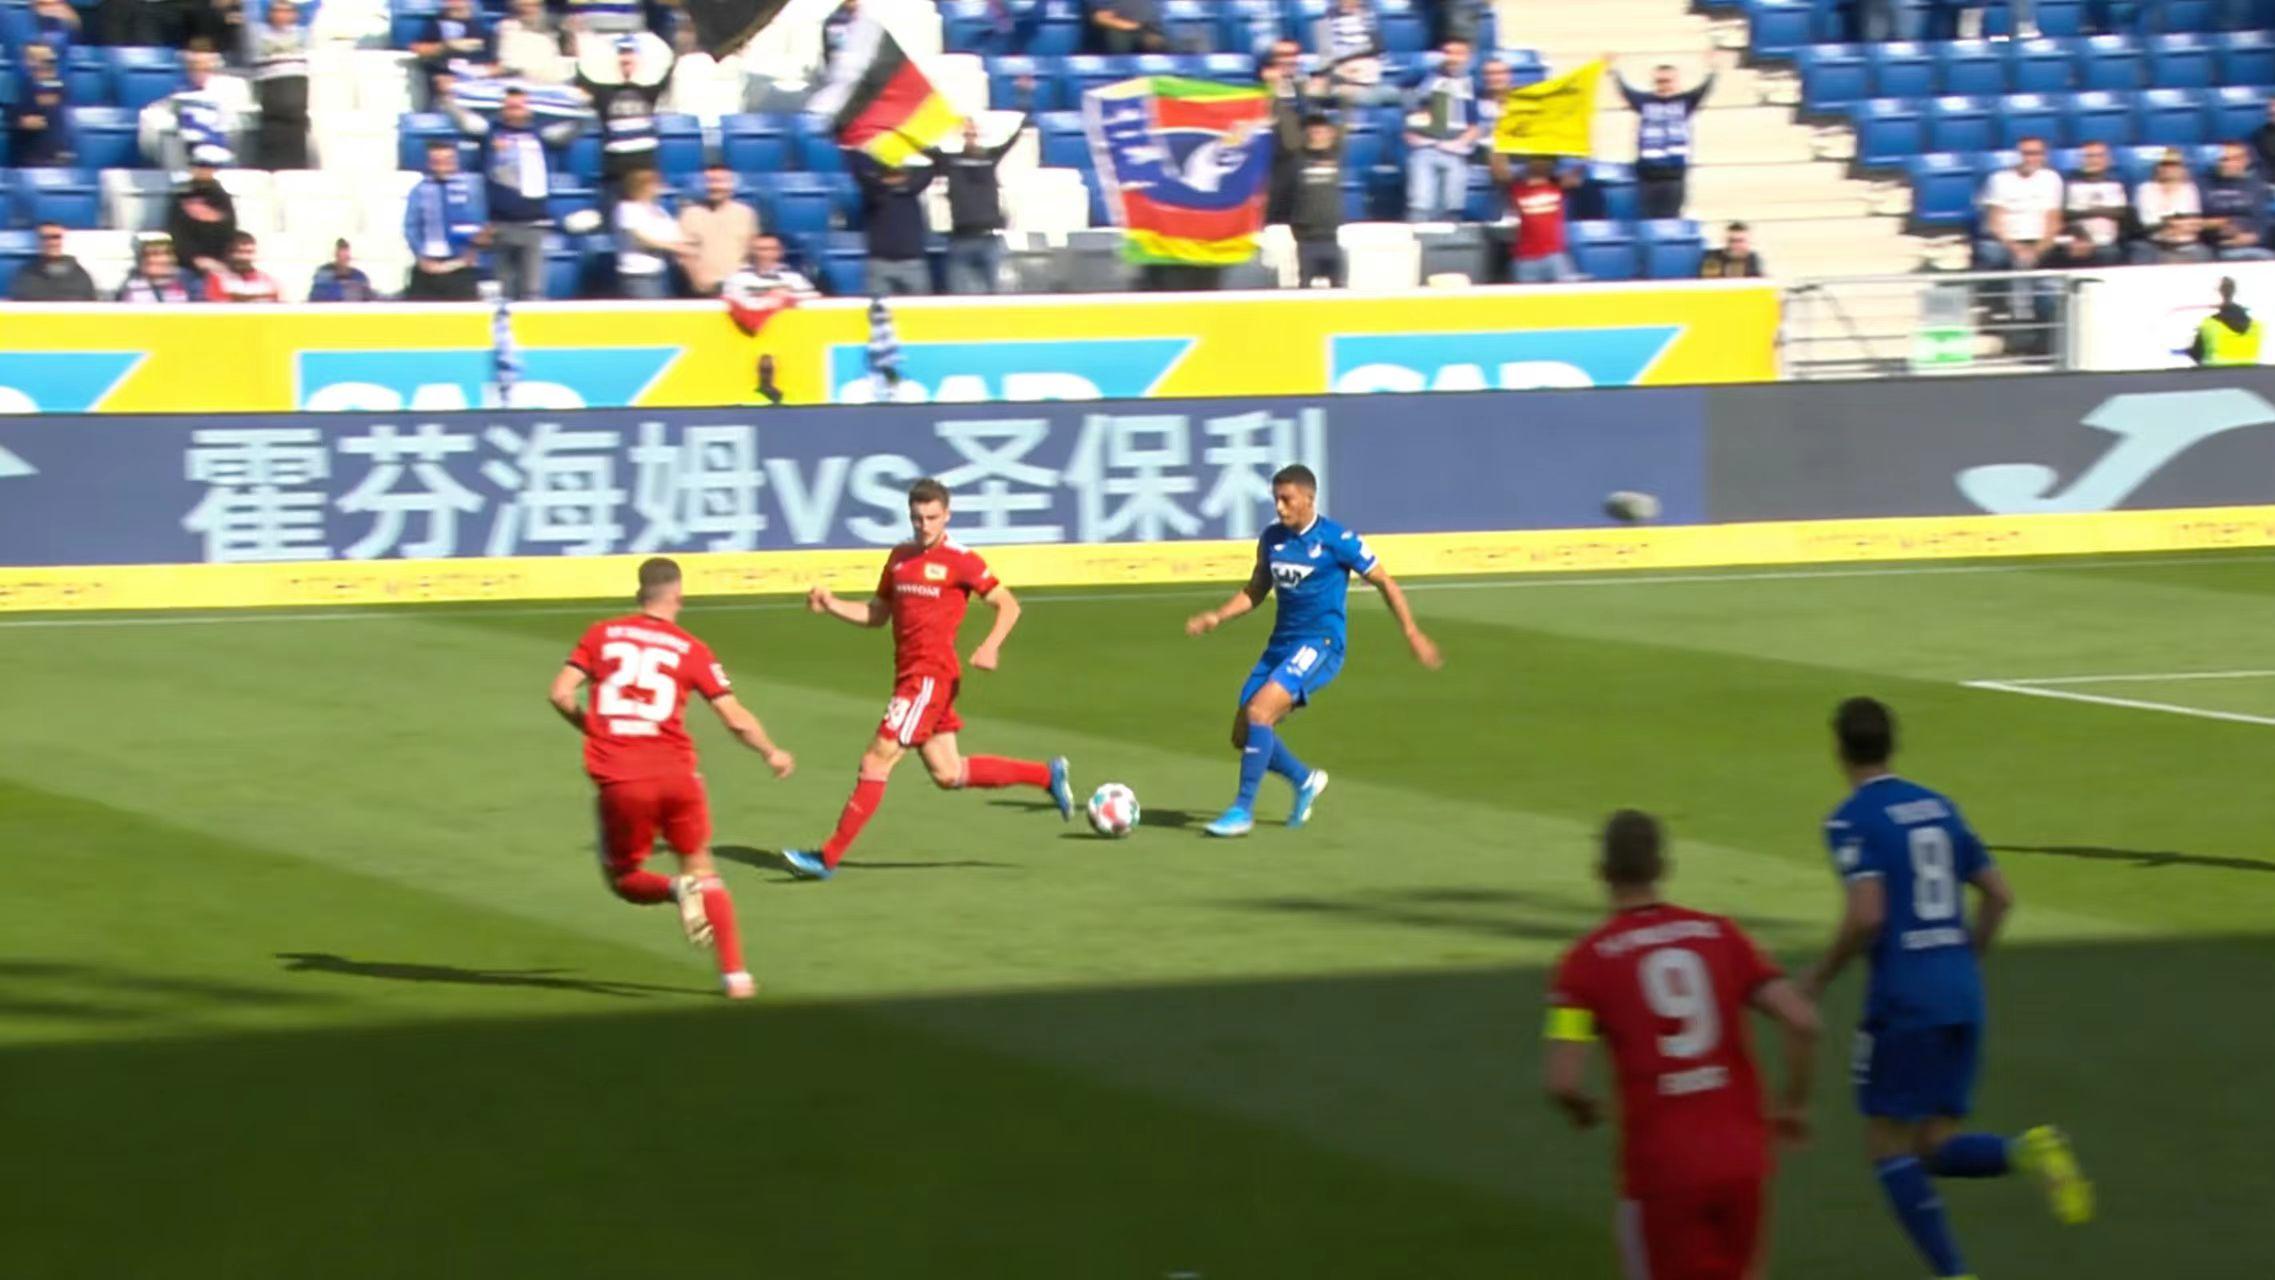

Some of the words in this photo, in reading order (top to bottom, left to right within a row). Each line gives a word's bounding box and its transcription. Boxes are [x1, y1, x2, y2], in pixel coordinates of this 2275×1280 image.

[597, 641, 680, 722] 25
[1908, 826, 1957, 920] 8
[1636, 947, 1721, 1059] 9
